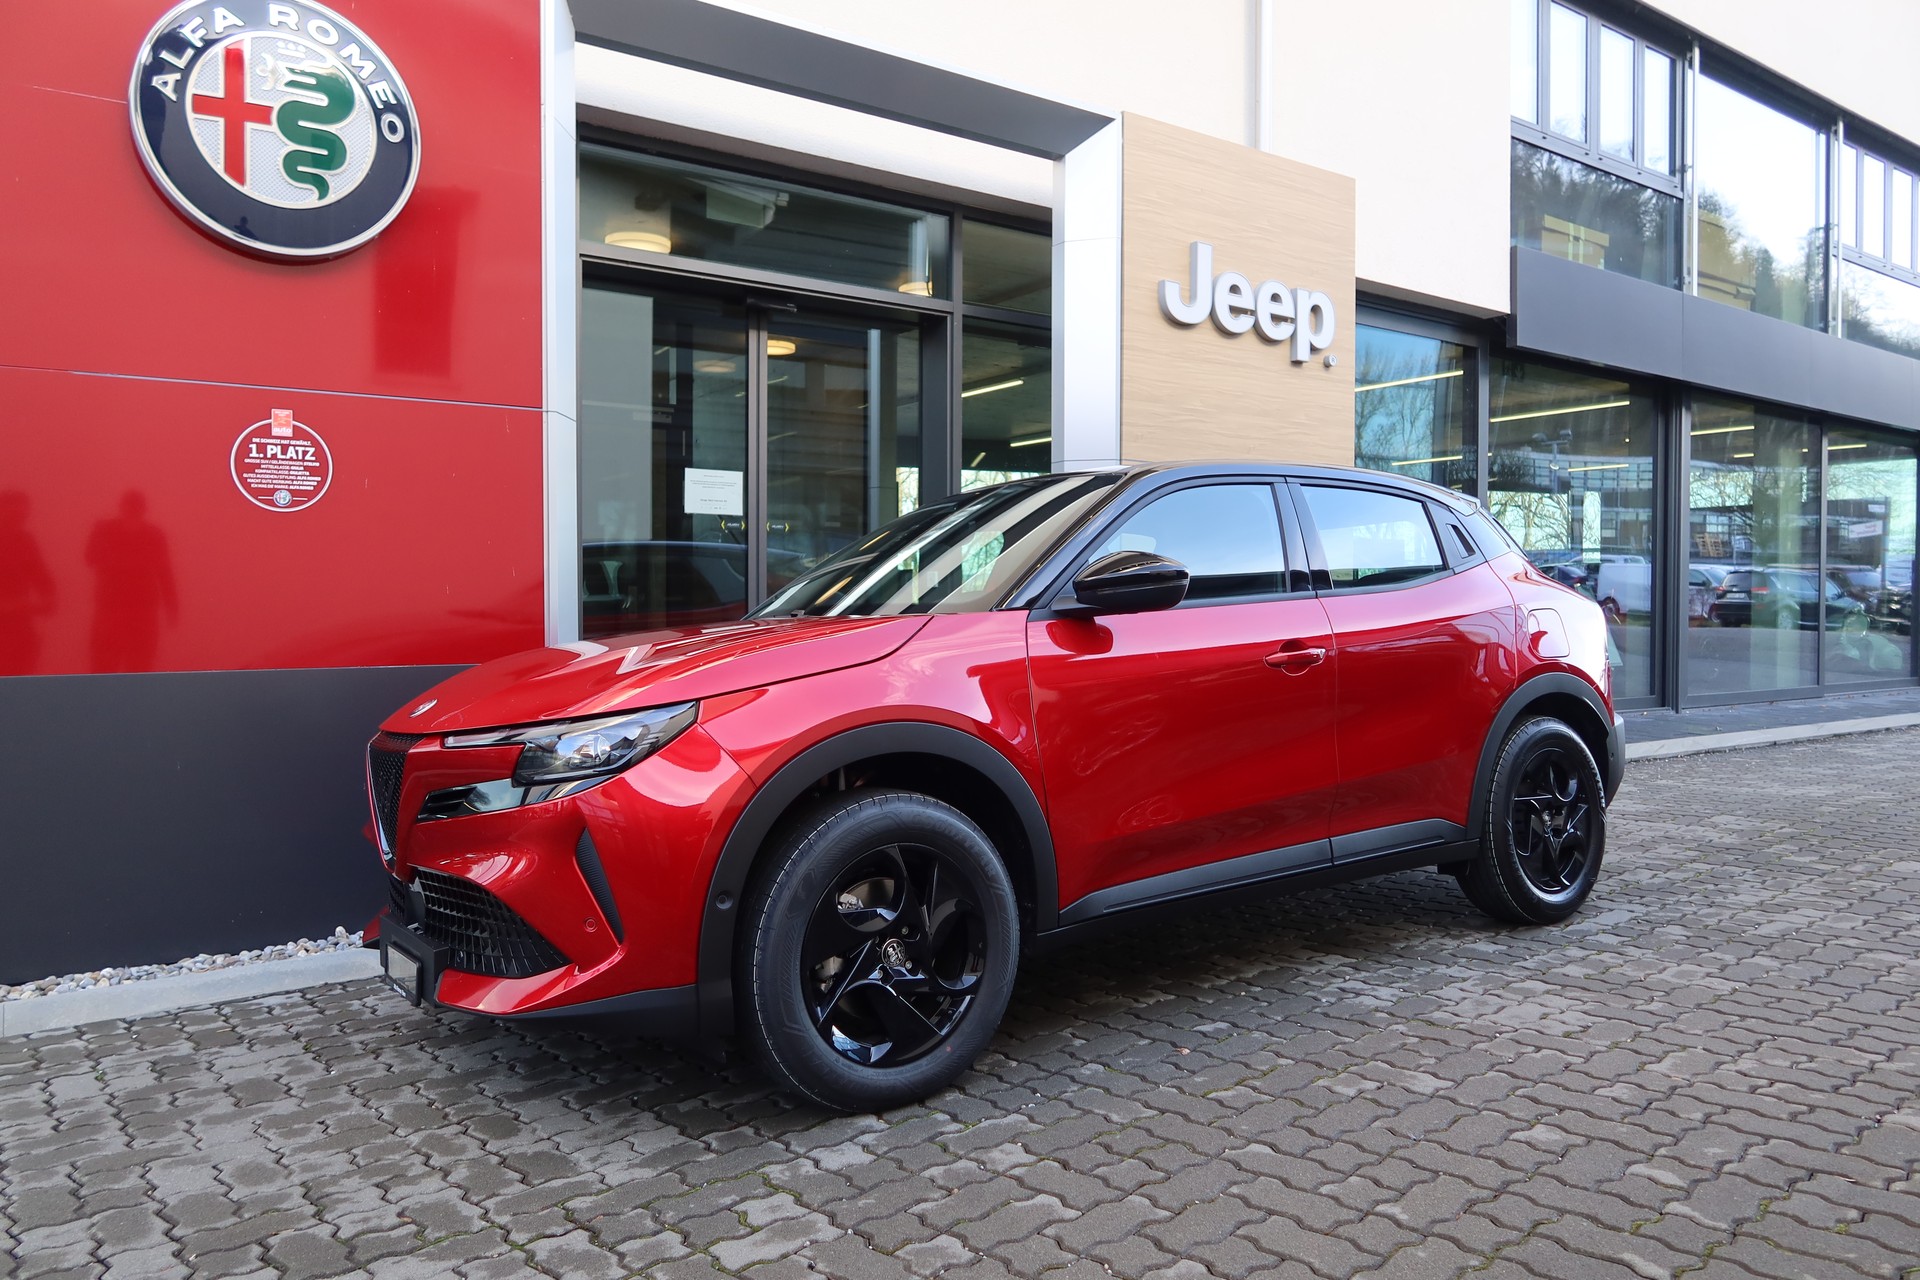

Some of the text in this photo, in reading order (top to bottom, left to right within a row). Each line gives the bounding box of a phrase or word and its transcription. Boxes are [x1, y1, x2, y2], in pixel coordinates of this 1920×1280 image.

[152, 3, 405, 143] ALFA ROMEO
[1158, 240, 1335, 364] Jeep
[248, 444, 316, 460] 1. PLATZ
